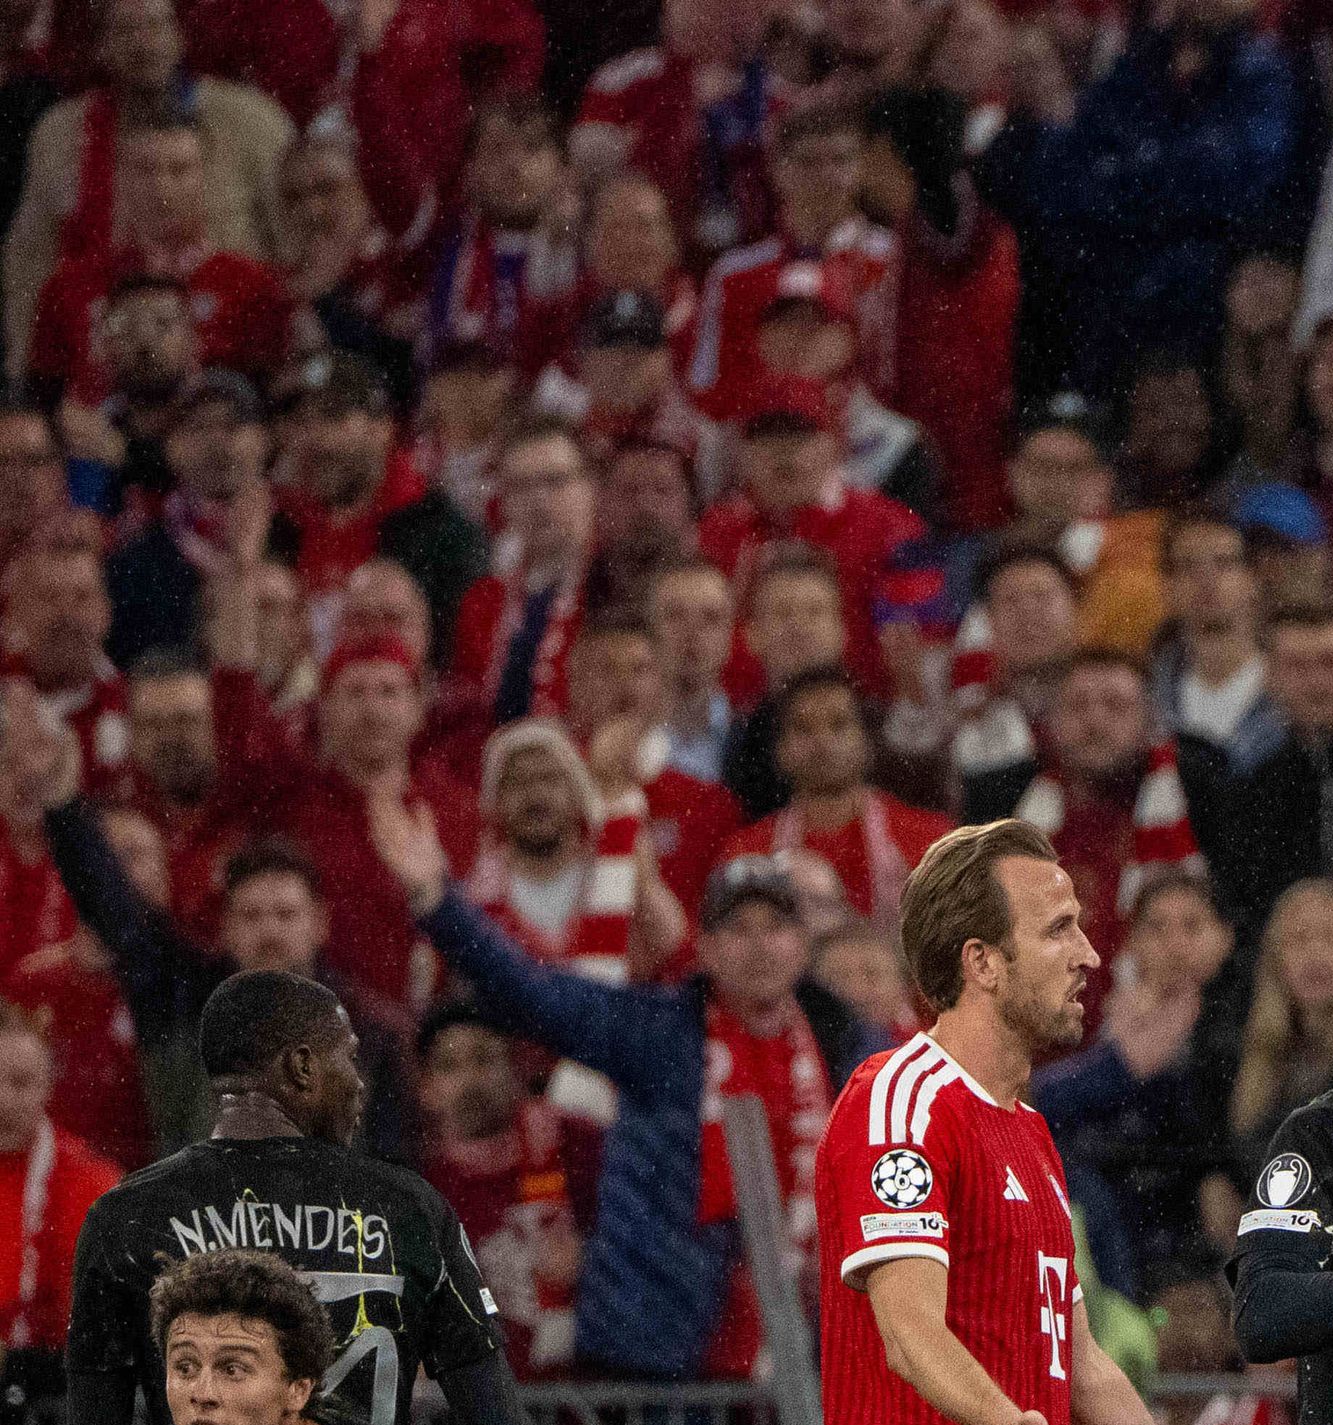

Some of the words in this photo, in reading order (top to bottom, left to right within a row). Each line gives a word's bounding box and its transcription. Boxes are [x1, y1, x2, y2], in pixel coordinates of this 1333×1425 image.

[169, 1202, 386, 1260] N.MENDES
[919, 1217, 940, 1231] 10
[1290, 1214, 1310, 1226] 10
[1038, 1250, 1068, 1380] T
